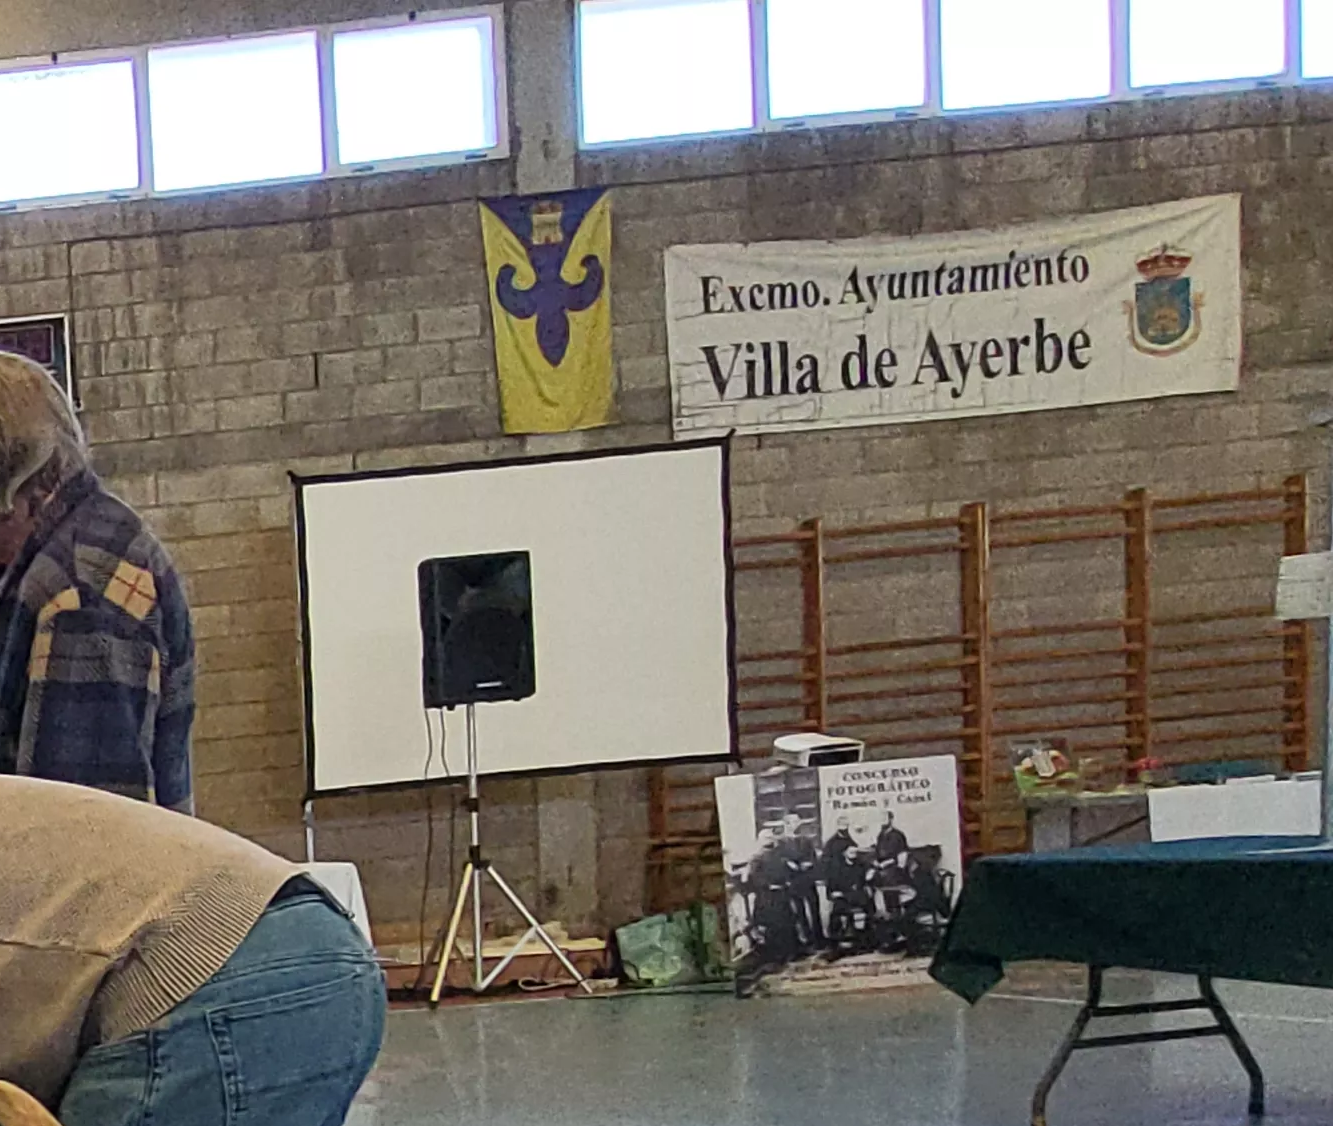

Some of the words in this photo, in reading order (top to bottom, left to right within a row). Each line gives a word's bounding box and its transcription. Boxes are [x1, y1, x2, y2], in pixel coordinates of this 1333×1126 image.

[699, 274, 831, 315] Excmo.
[840, 249, 1091, 314] Ayuntamiento
[699, 340, 823, 400] Villa
[840, 333, 899, 391] de
[912, 317, 1093, 399] Ayerbe
[827, 778, 931, 798] FOTOGRÁFICO
[842, 766, 919, 781] CONCURSO
